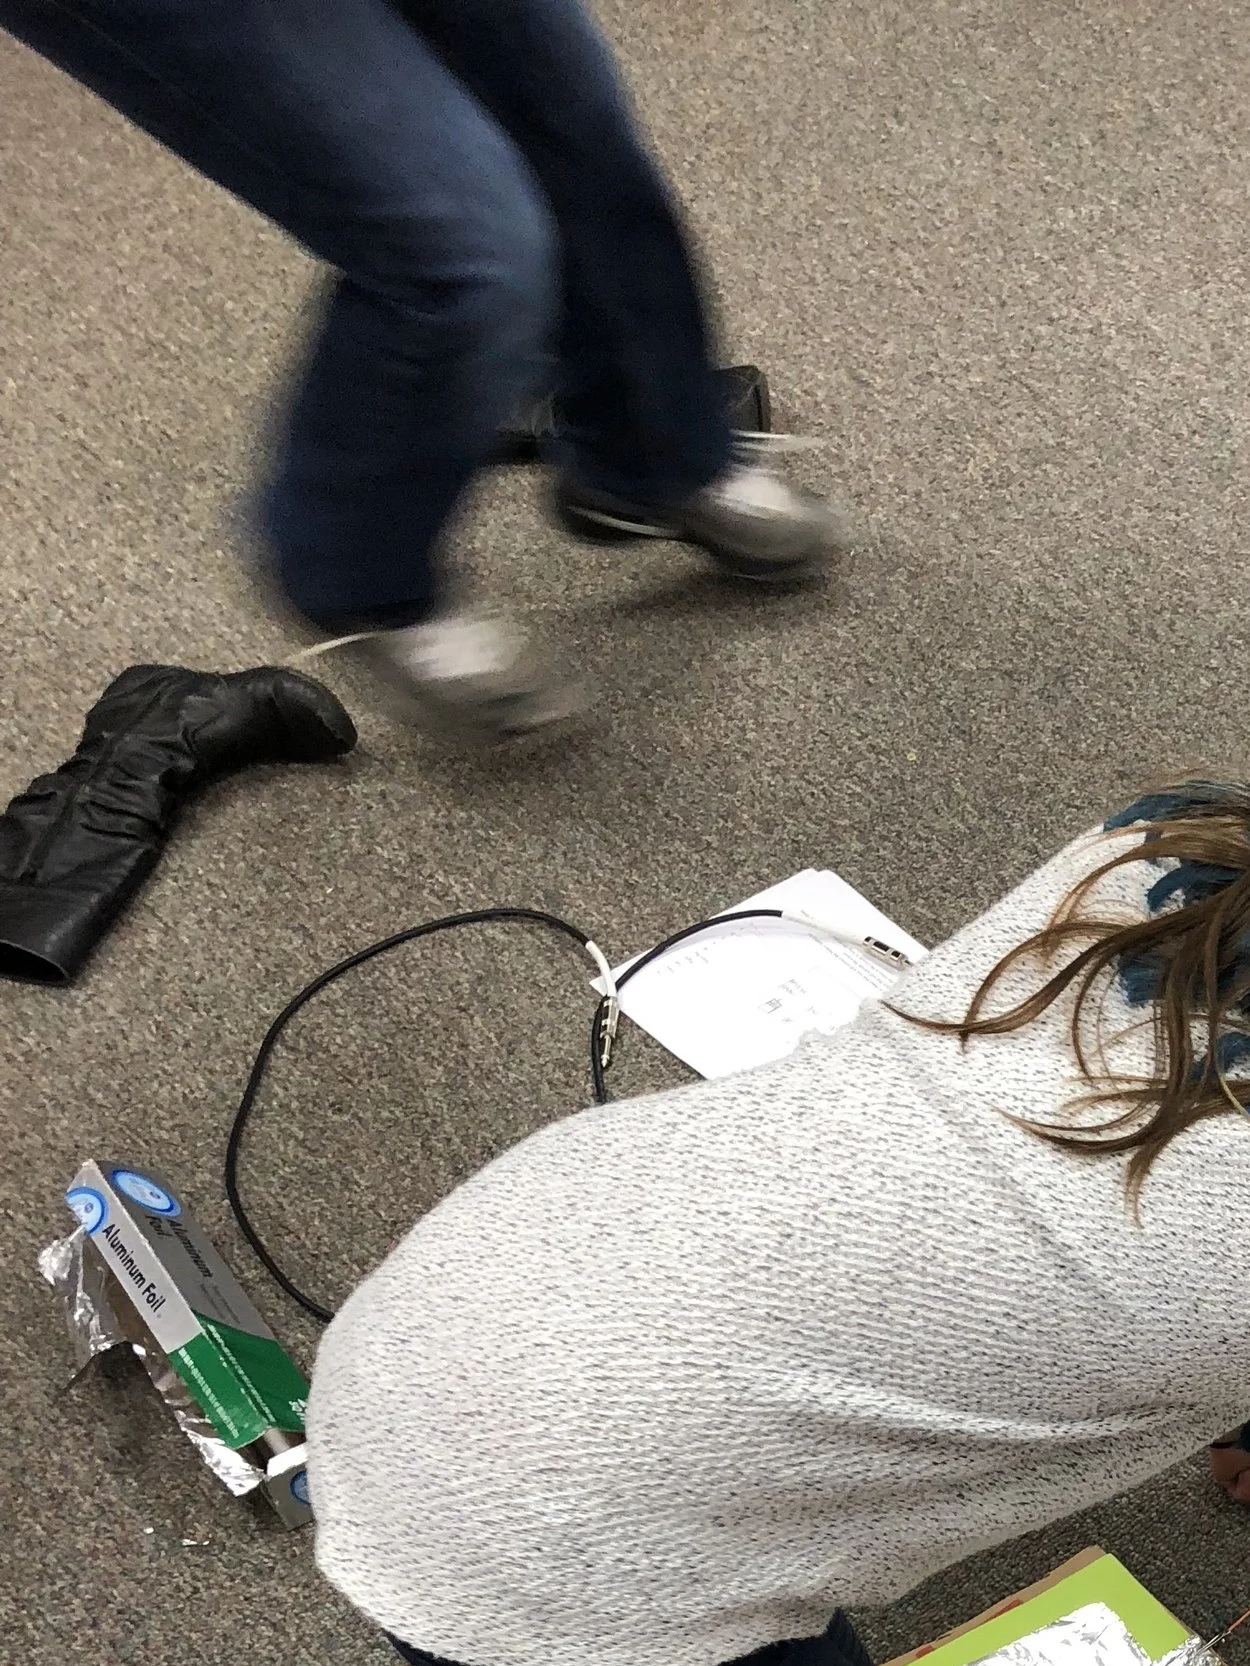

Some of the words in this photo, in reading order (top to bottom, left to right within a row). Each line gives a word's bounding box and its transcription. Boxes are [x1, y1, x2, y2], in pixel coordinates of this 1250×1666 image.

[102, 1224, 147, 1289] Aluminum
[142, 1282, 167, 1313] Foil
[167, 1219, 213, 1278] Aluminum
